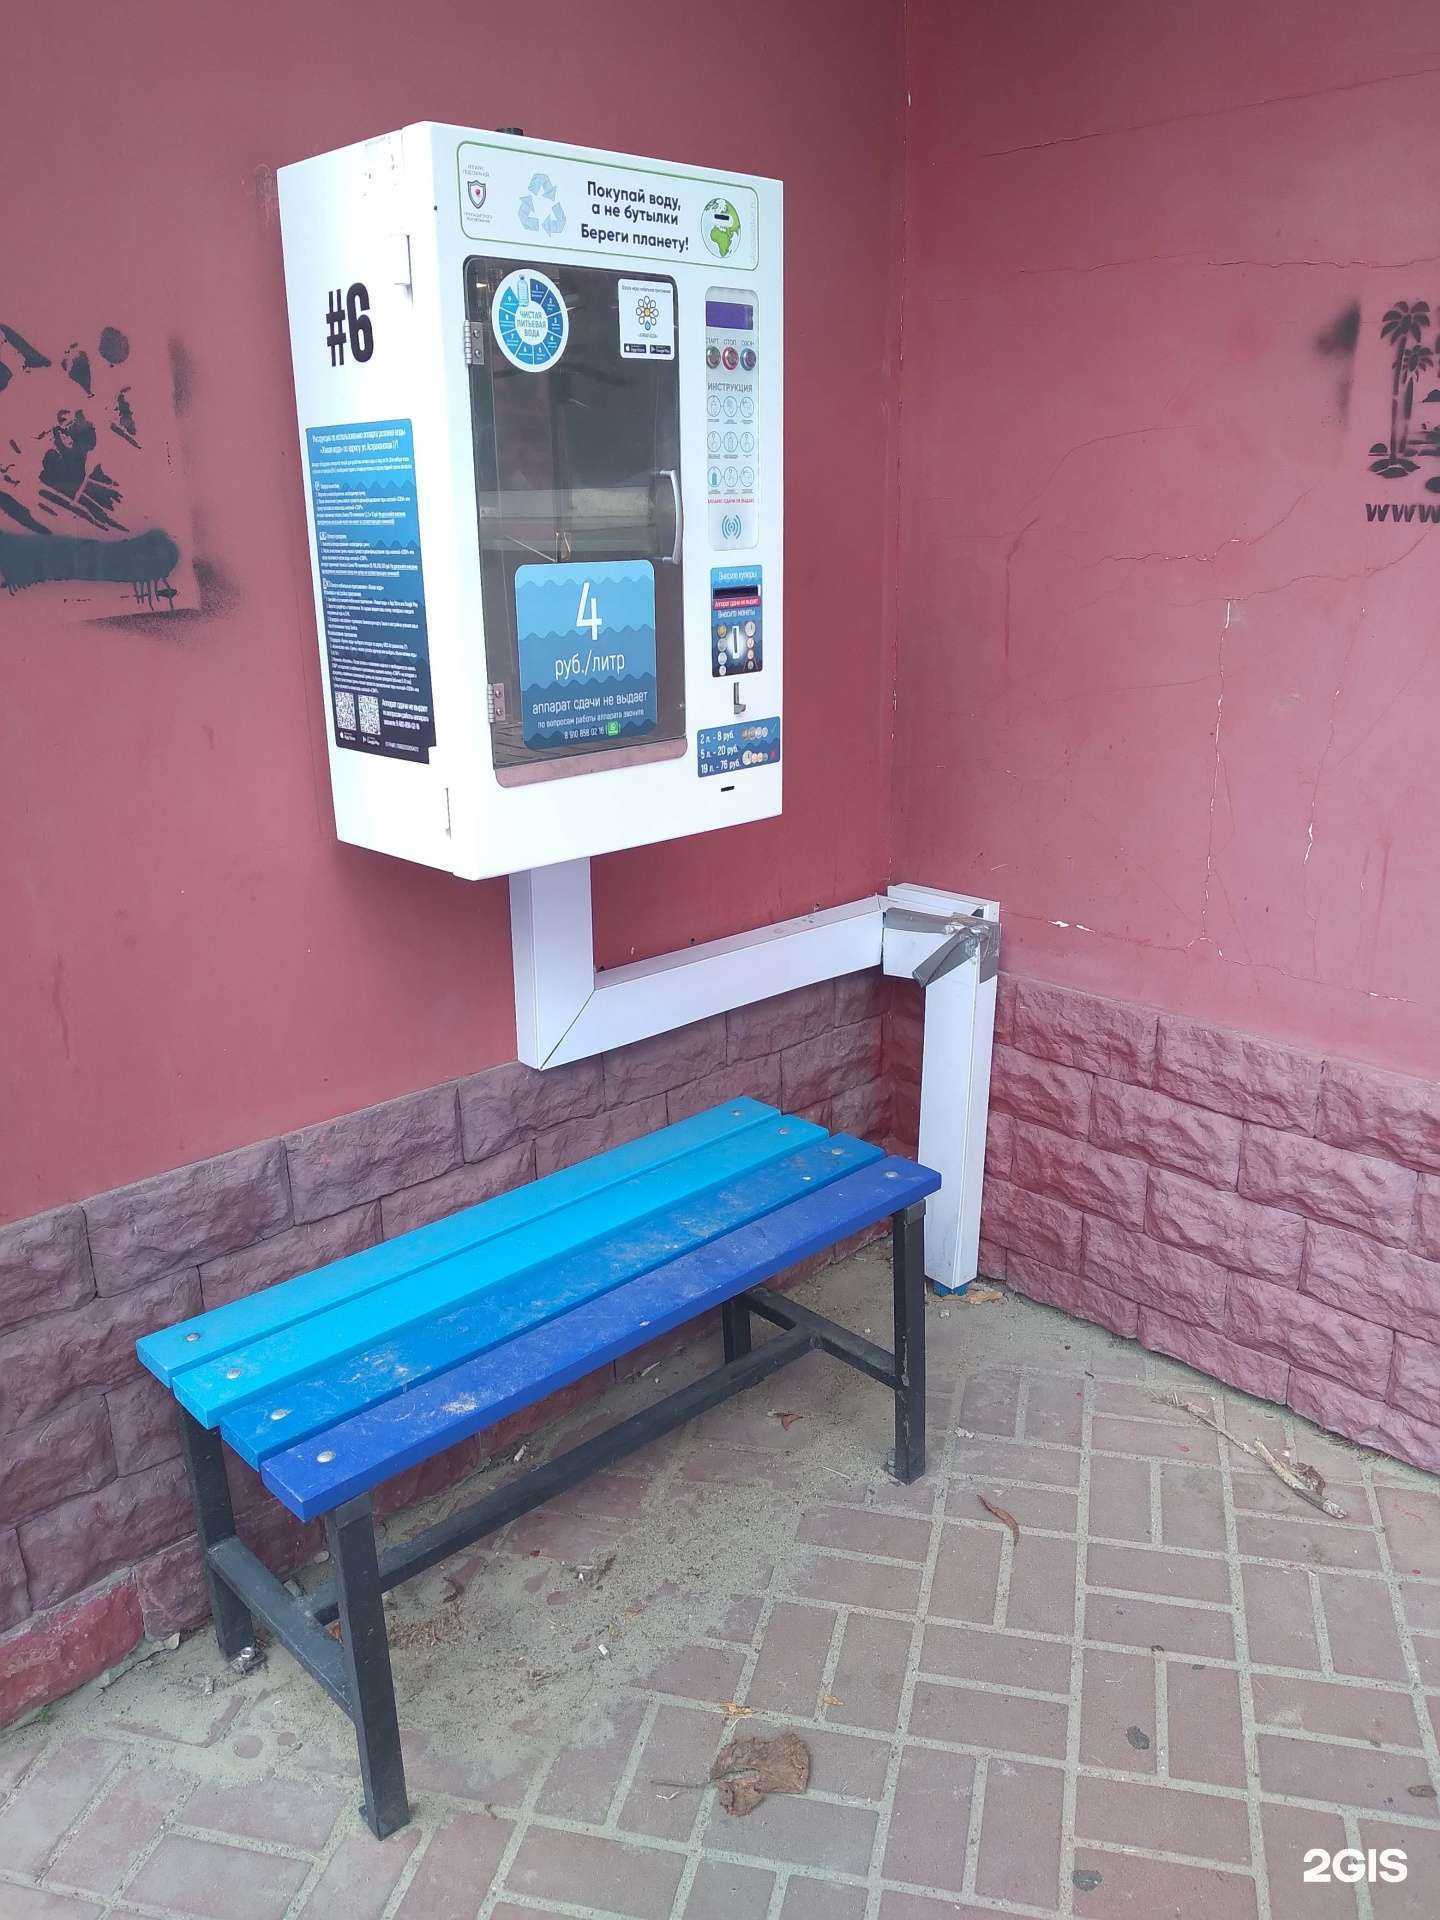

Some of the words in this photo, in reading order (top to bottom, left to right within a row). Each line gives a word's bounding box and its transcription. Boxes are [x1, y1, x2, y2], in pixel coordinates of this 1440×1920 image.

[587, 181, 645, 203] Покупай
[650, 193, 681, 211] воду,
[592, 204, 600, 214] а
[604, 205, 621, 217] не
[624, 205, 679, 225] бутылки
[581, 224, 629, 243] Береги
[633, 234, 689, 253] планету!
[326, 282, 374, 367] #6
[517, 319, 547, 328] ПИТЬЕВАЯ
[707, 382, 753, 392] ИНСТРУКЦИЯ
[576, 580, 603, 641] 4
[555, 650, 625, 680] руб./литр
[532, 700, 571, 715] аппарат
[573, 697, 601, 711] сдачи
[603, 695, 614, 706] не
[616, 691, 648, 705] выдает
[537, 720, 546, 729] по
[546, 718, 575, 728] вопросам
[576, 714, 596, 725] работы
[591, 727, 598, 736] 02
[700, 733, 705, 745] 2
[717, 730, 722, 741] 8
[722, 729, 735, 742] руб.
[700, 749, 705, 759] 5
[717, 745, 726, 756] 20
[727, 744, 738, 756] руб.
[701, 763, 708, 774] 19
[720, 760, 728, 770] 76
